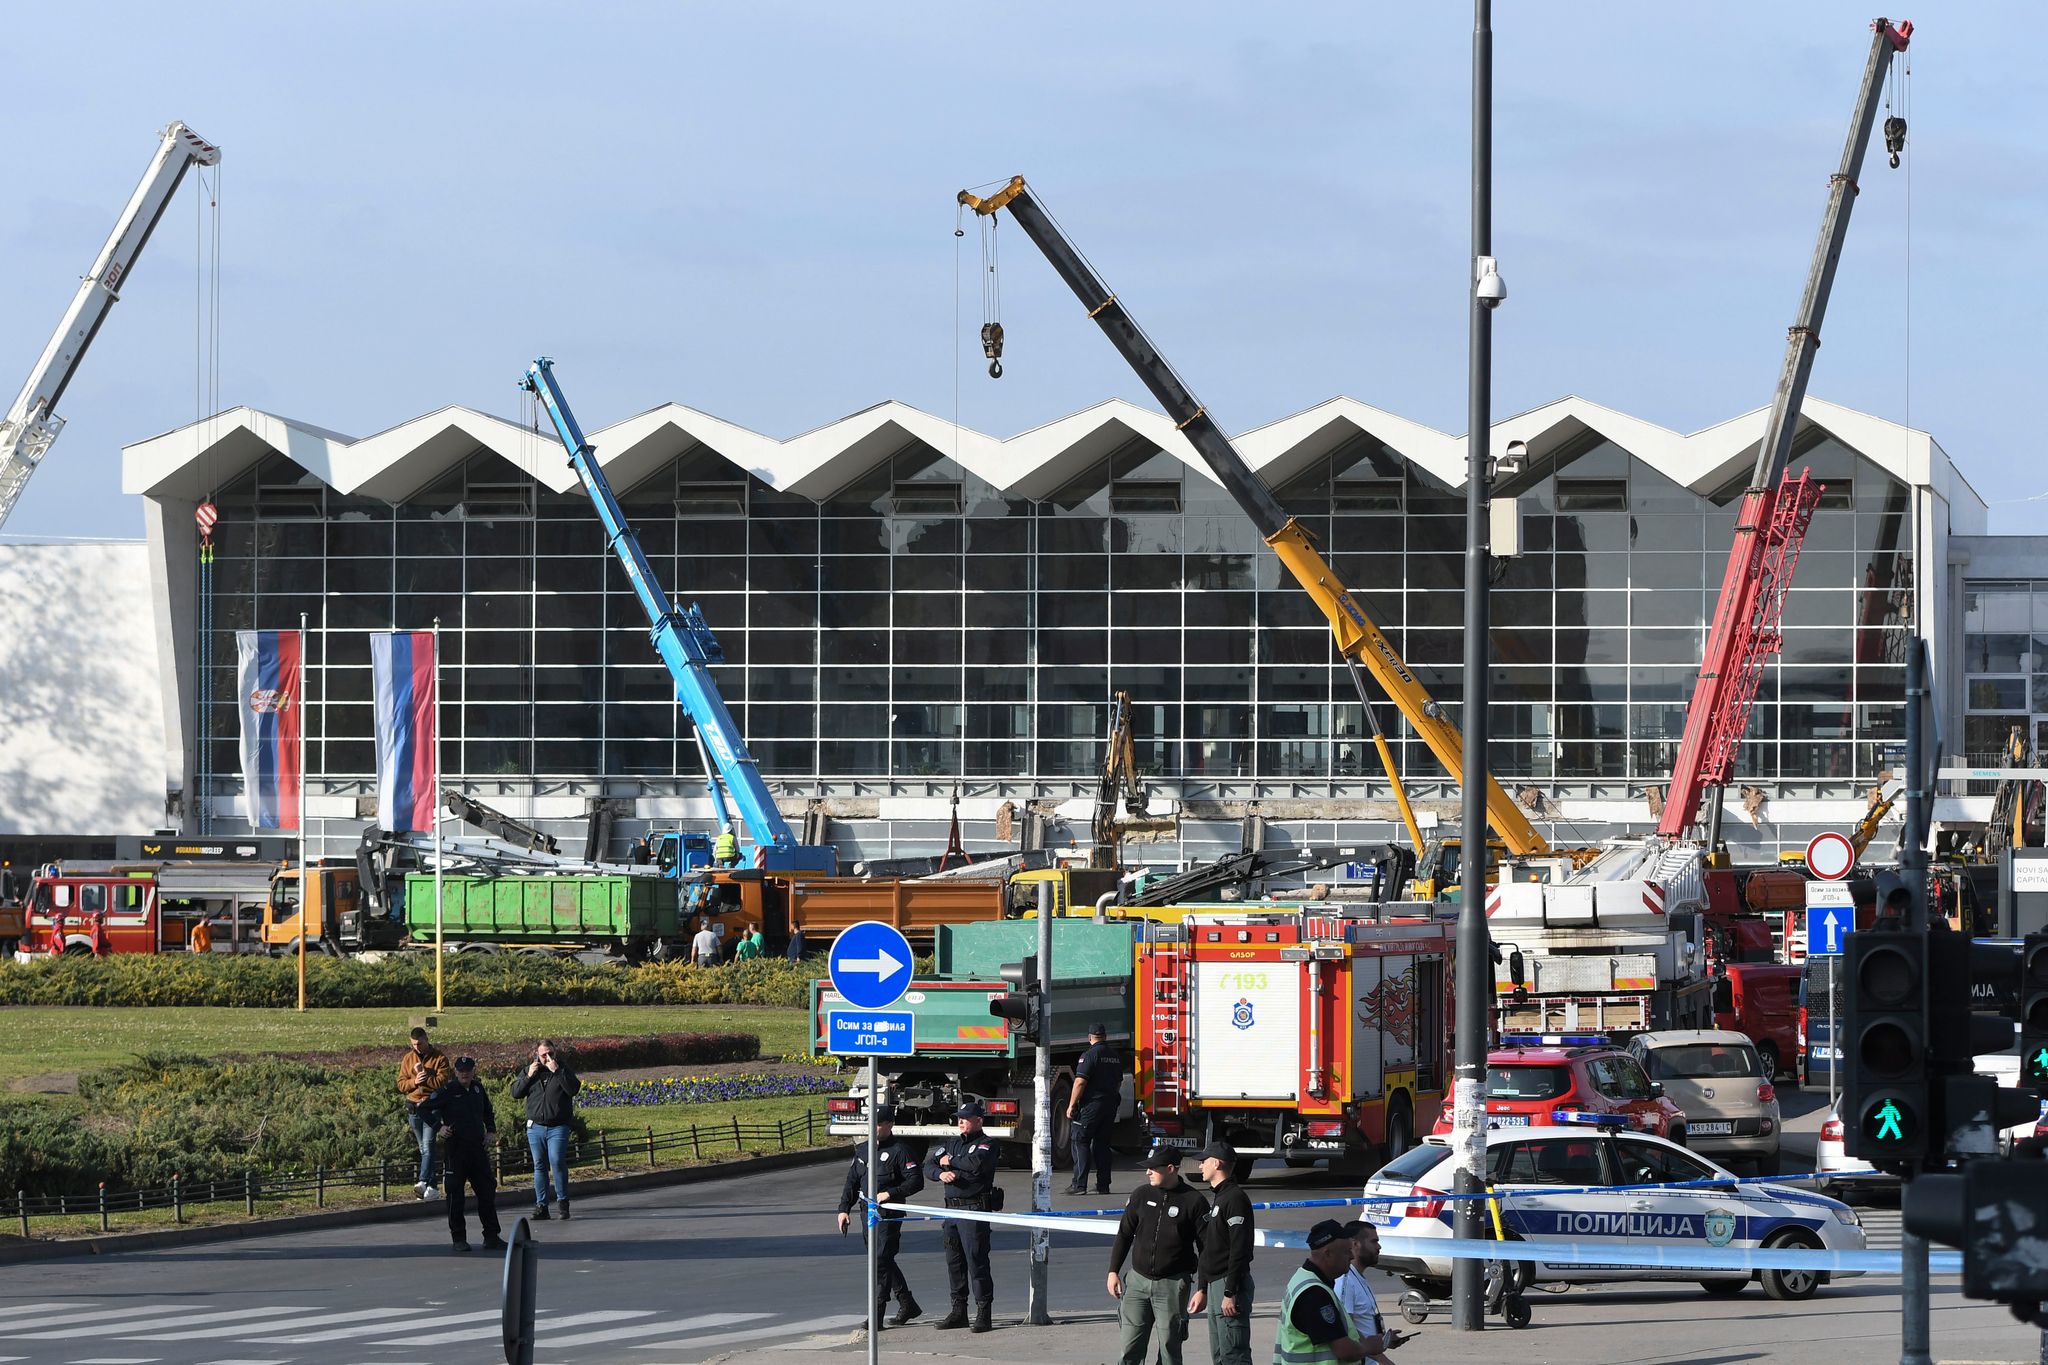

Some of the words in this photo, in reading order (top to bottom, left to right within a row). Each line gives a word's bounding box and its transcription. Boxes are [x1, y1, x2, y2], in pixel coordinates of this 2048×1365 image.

[1233, 973, 1268, 990] 193
[837, 1018, 860, 1030] Осим
[862, 1022, 872, 1030] за
[854, 1034, 888, 1046] ЈГСП-а
[1164, 1032, 1174, 1041] 90
[1308, 1141, 1338, 1149] MAN
[1556, 1213, 1695, 1236] ПОЛИЦИЈА
